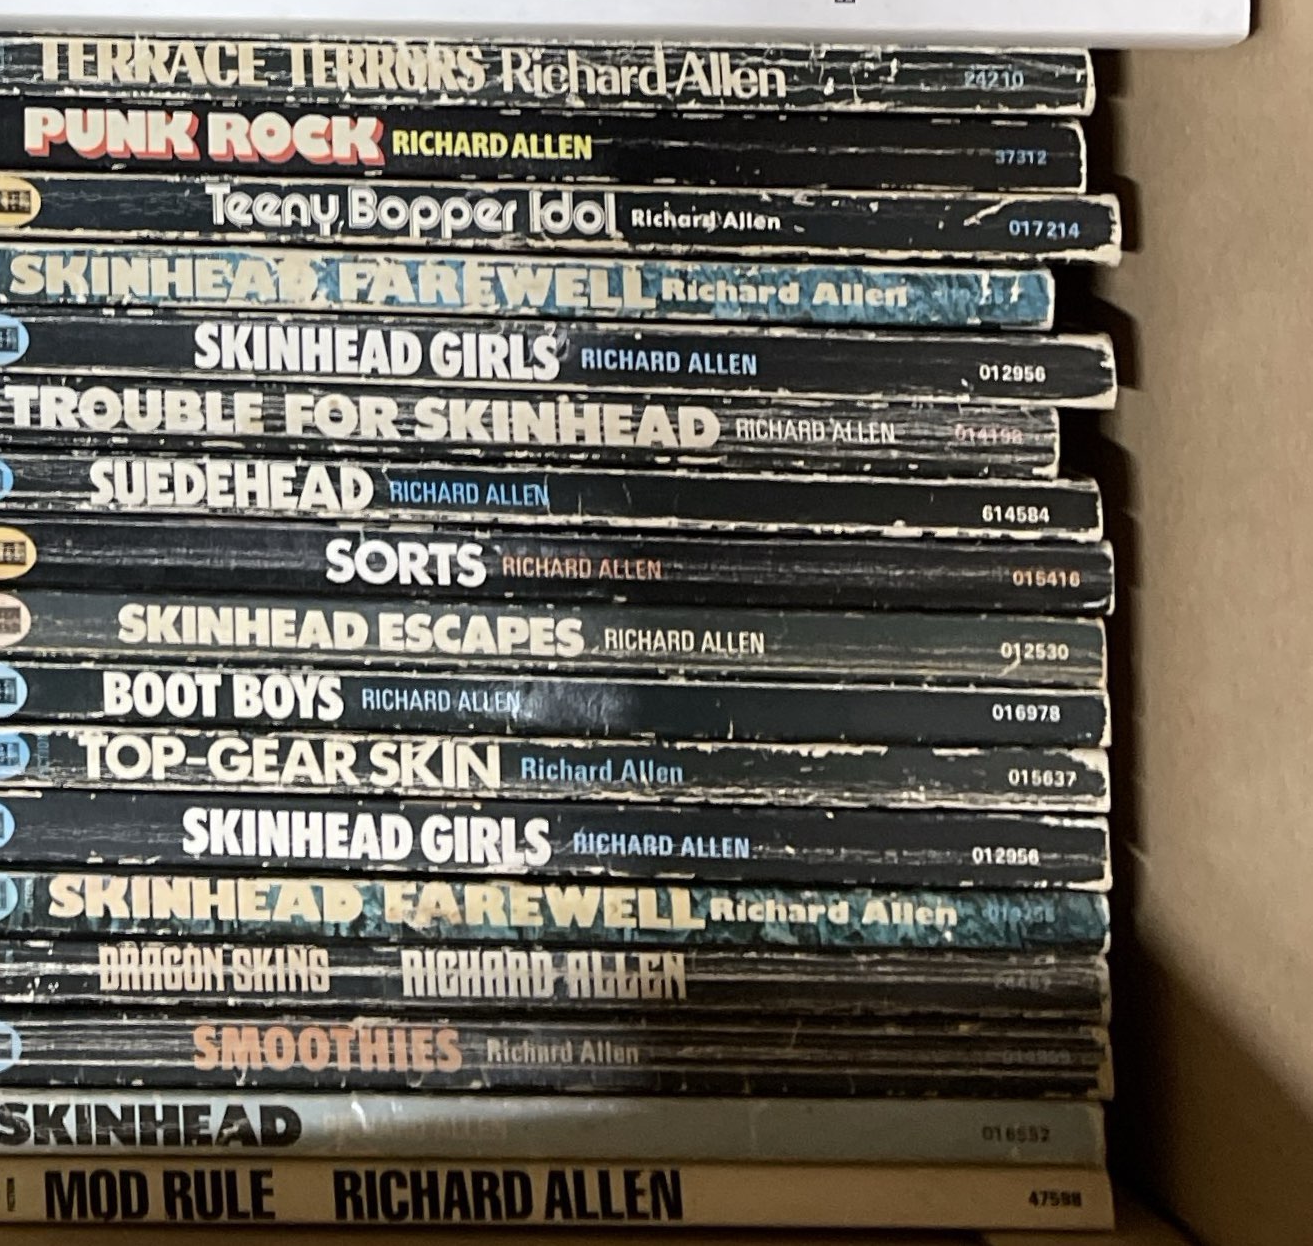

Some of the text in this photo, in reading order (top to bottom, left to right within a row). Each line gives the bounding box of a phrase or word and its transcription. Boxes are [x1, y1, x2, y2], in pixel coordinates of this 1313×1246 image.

[41, 37, 268, 86] TERRACE
[289, 41, 488, 93] TERRORS
[500, 45, 666, 98] Richard
[675, 50, 787, 98] Allen
[24, 107, 199, 160] PUNK
[208, 112, 385, 165] ROCK
[392, 128, 509, 159] RICHARD
[511, 133, 592, 160] ALLEN
[995, 149, 1047, 166] 37312
[205, 182, 1081, 240] Teeny Bopper Idol Richard Allen 017214
[9, 254, 318, 305] SKINHEAD
[338, 261, 657, 310] FAREWELL
[661, 279, 807, 305] Richard
[812, 281, 908, 308] Allen
[194, 321, 1047, 384] SKINHEAD GIRLS RICHARD ALLEN 012956
[4, 384, 896, 448] TROUBLE FOR SKINHEAD RICHARD ALLEN
[89, 459, 375, 512] SUEDEHEAD
[389, 481, 480, 504] RICHARD
[486, 484, 549, 507] ALLEN
[325, 537, 487, 588] SORTS
[502, 555, 592, 580] RICHARD
[598, 558, 663, 581] ALLEN
[117, 603, 1070, 662] SKINHEAD ESCAPES RICHARD ALLEN 012530
[103, 671, 1061, 723] BOOT BOYS RICHARD ALLEN 016978
[79, 733, 363, 784] TOP-GEAR
[368, 739, 500, 790] SKIN
[520, 756, 612, 783] Richard
[621, 758, 684, 785] Allen
[182, 806, 413, 864] SKINHEAD
[421, 814, 552, 868] GIRLS
[573, 830, 673, 857] RICHARD
[681, 835, 750, 860] ALLEN
[48, 876, 364, 922] SKINHEAD
[385, 880, 706, 931] FAREWELL
[710, 896, 849, 925] Richard
[861, 898, 958, 927] Allen
[98, 941, 687, 1000] DRAGON SKINS RICHARD ALLEN
[192, 1024, 639, 1073] SMOOTHIES Richard Allen
[44, 1168, 150, 1222] MOD
[163, 1168, 277, 1221] RULE
[333, 1168, 534, 1222] RICHARD
[544, 1168, 684, 1222] ALLEN
